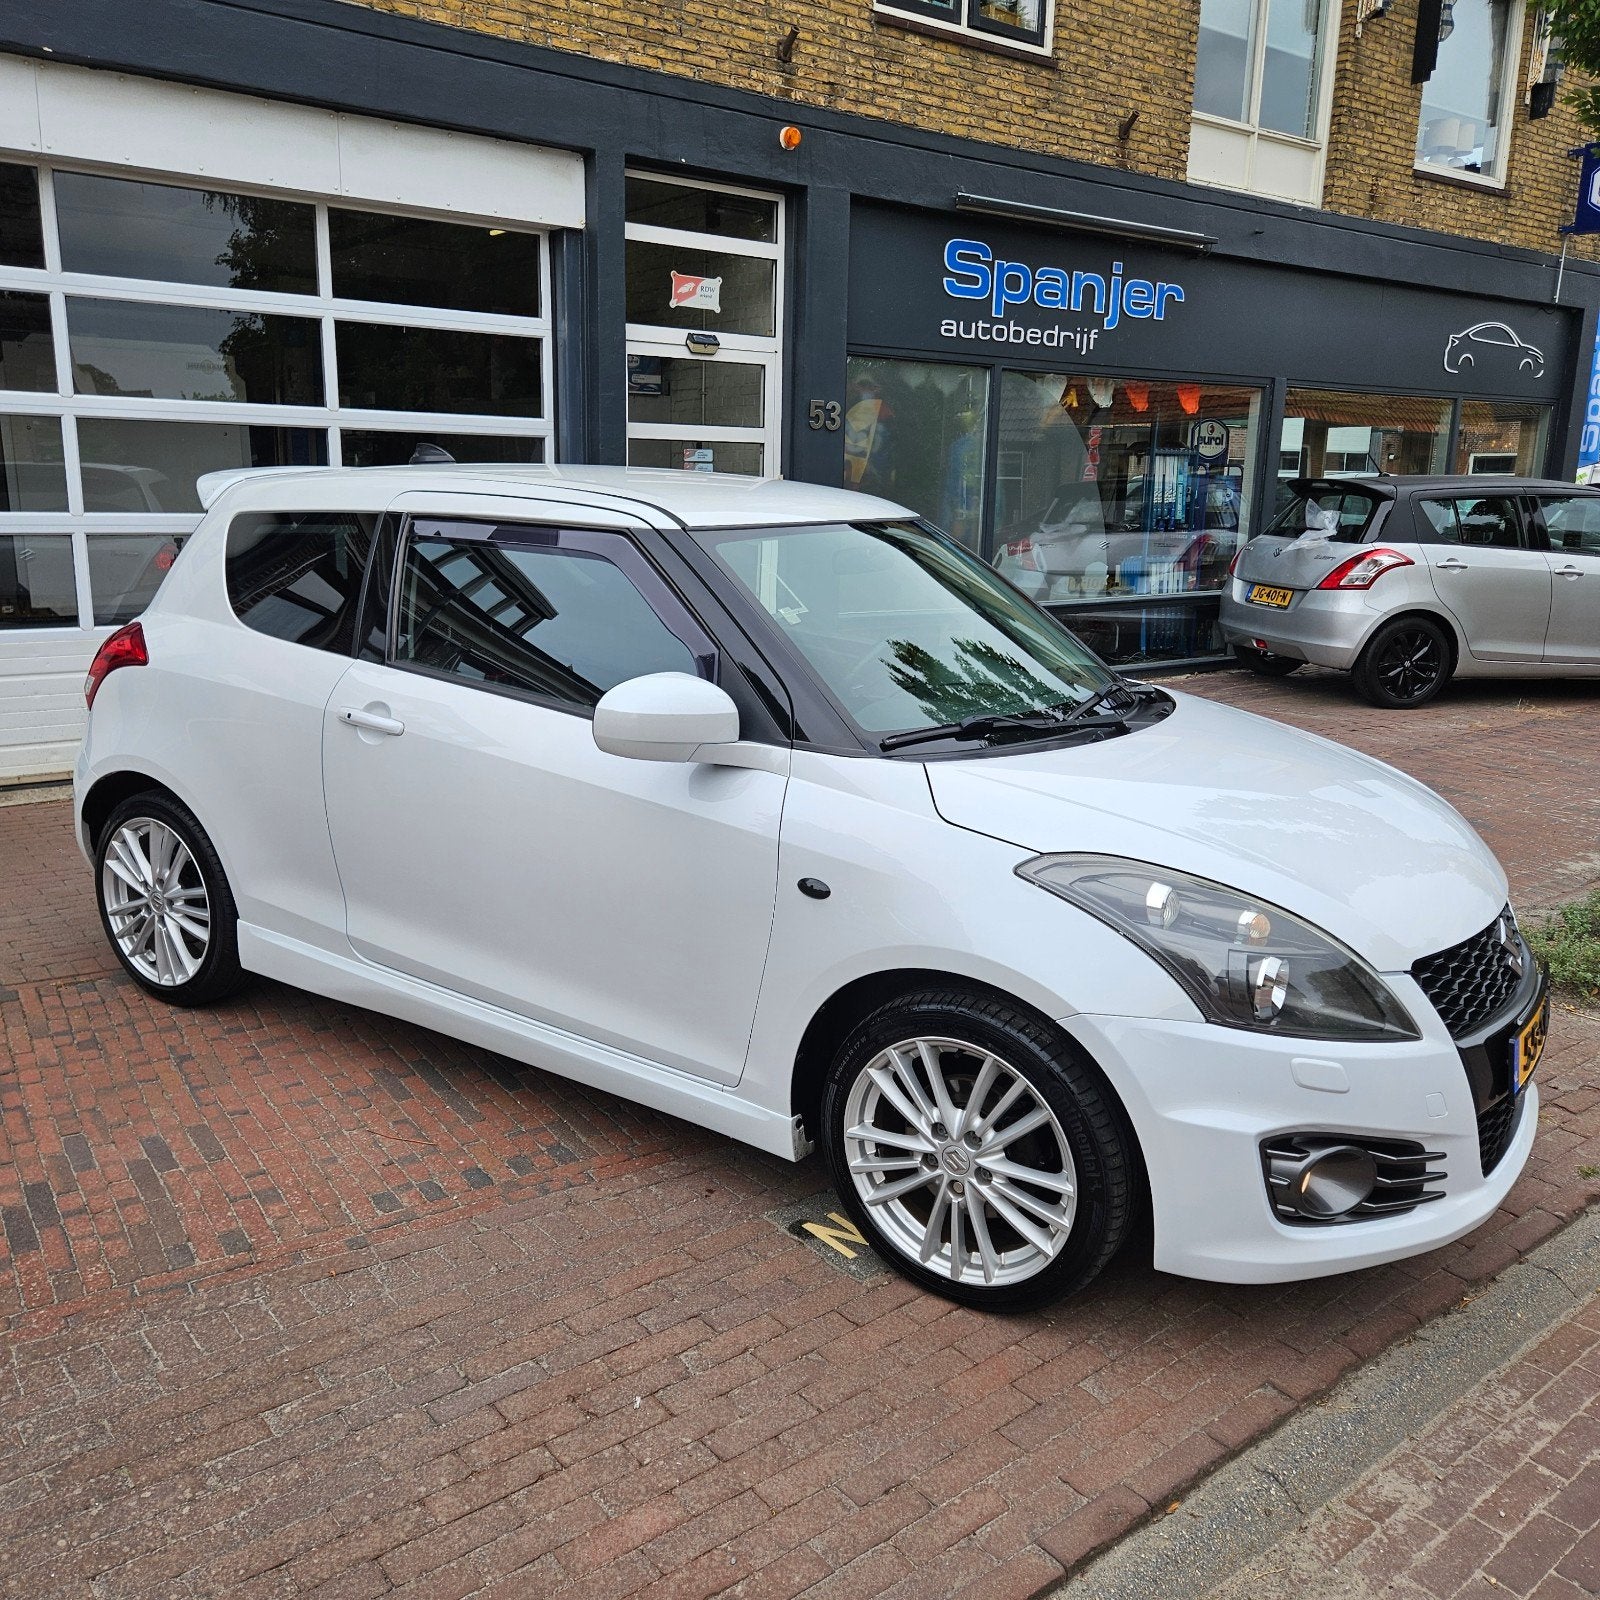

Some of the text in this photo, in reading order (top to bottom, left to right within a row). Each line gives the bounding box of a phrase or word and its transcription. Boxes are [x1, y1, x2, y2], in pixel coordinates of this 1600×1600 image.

[942, 238, 1186, 329] Spanjer
[940, 318, 1099, 355] autobedrijf
[808, 399, 842, 431] 53
[1197, 433, 1225, 446] eurol
[1253, 587, 1289, 604] JG-401-N
